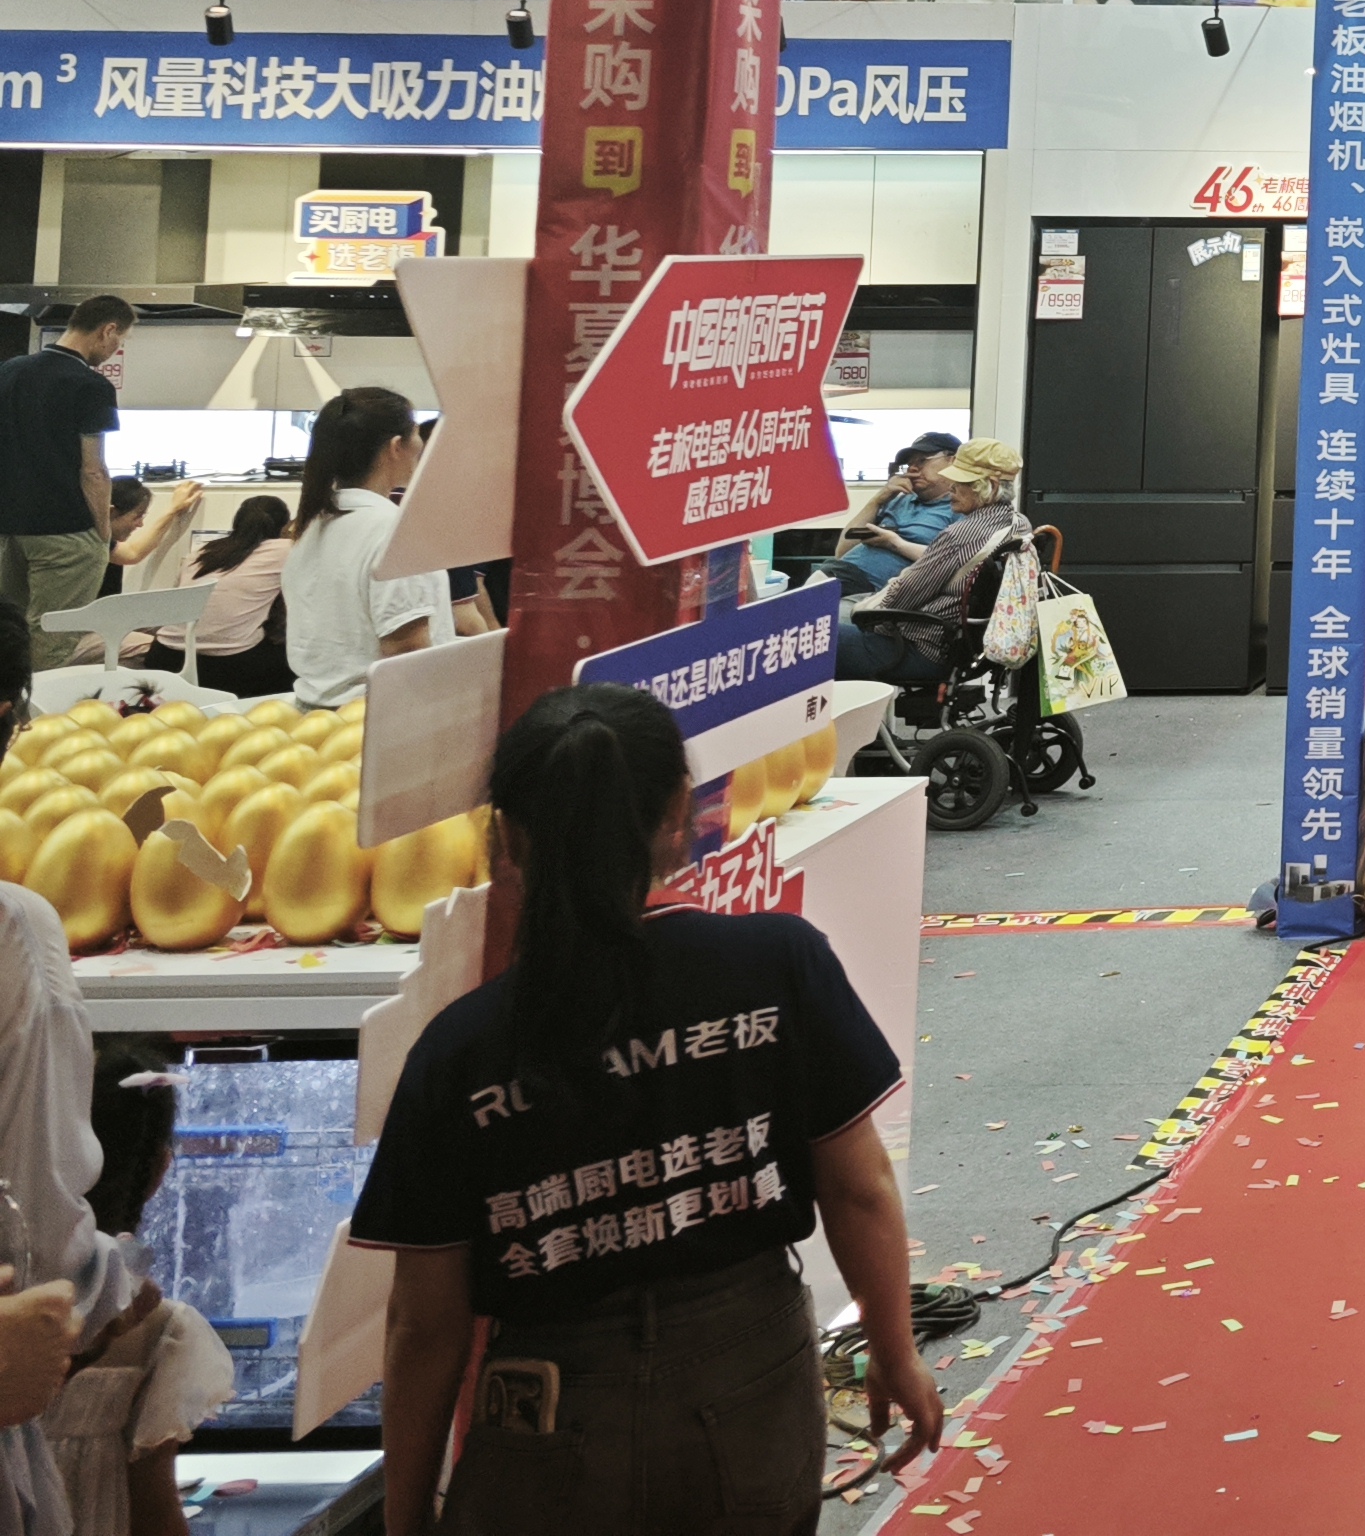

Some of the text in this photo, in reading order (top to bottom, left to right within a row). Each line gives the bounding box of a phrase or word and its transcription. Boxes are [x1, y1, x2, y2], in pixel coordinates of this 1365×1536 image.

[308, 205, 398, 235] 买厨电
[1187, 230, 1243, 267] 展示机
[662, 291, 828, 390] 中国新厨房节
[646, 404, 812, 478] 老板电器46周年庆
[682, 465, 772, 526] 感恩有礼
[1081, 673, 1120, 699] VIP
[683, 1006, 780, 1060] 老板
[484, 1111, 773, 1236] 高端厨电选老板
